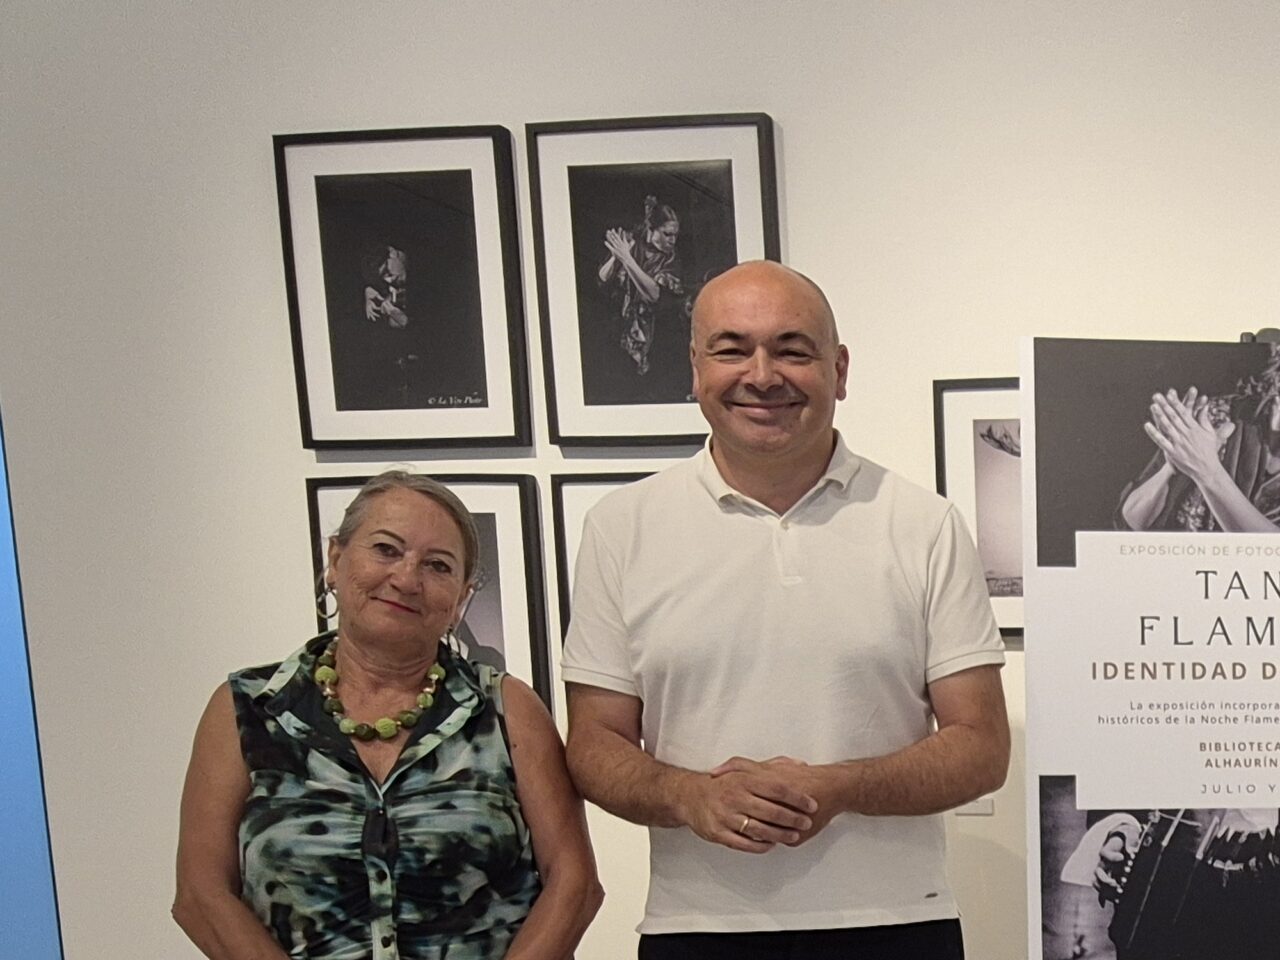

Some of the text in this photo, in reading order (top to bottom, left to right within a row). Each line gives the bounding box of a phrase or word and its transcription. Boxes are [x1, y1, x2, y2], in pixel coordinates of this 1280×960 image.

[1120, 545, 1206, 557] EXPOSICIÓN
[1212, 546, 1230, 557] DE
[1092, 662, 1247, 681] IDENTIDAD
[1130, 701, 1143, 711] La
[1148, 701, 1216, 713] exposición
[1220, 701, 1280, 713] incorpora
[1098, 715, 1161, 725] históricos
[1165, 715, 1180, 725] de
[1185, 715, 1196, 725] la
[1200, 715, 1240, 725] Noche
[1204, 757, 1279, 769] ALHAURÍN
[1201, 784, 1257, 795] JULIO
[1268, 784, 1277, 794] Y
